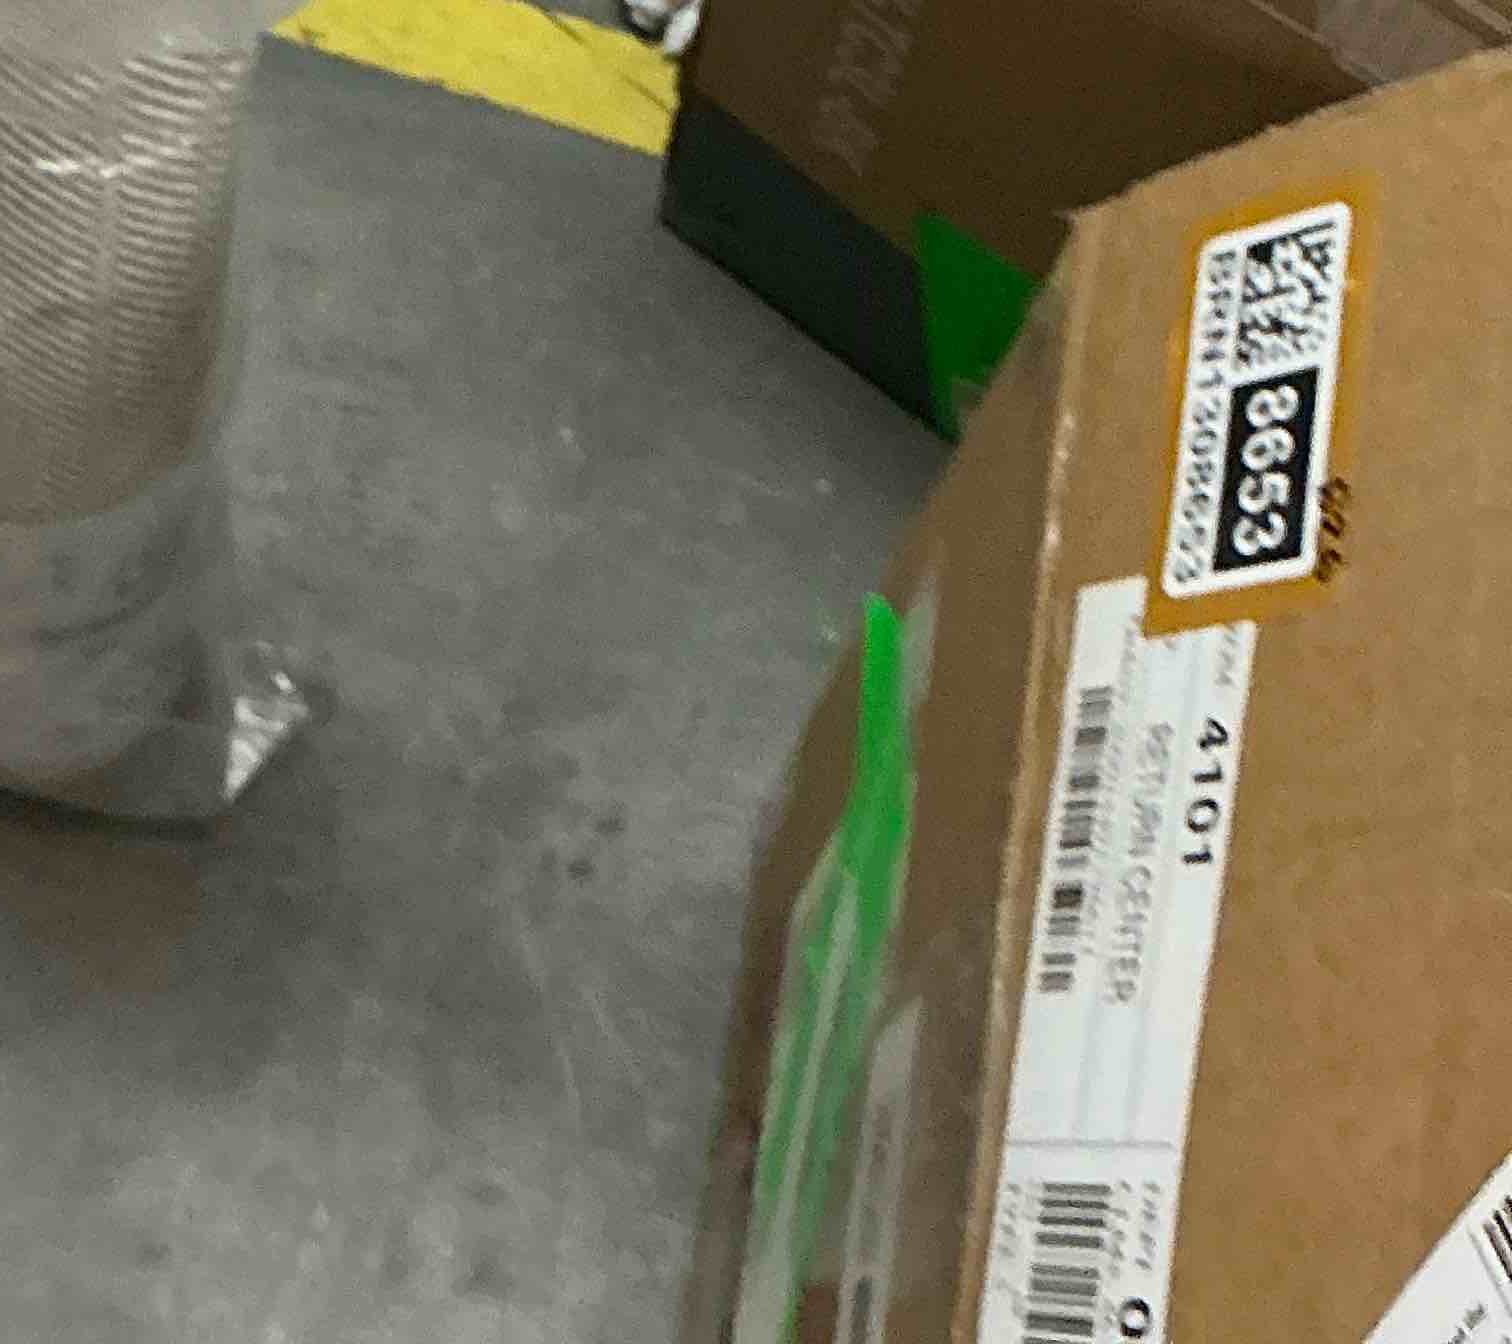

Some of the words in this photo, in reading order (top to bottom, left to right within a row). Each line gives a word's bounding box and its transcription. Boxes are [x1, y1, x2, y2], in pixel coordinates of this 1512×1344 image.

[1233, 384, 1300, 555] 8653
[1127, 723, 1174, 858] RETURN
[1182, 718, 1229, 865] 4101
[1107, 865, 1153, 1003] CENTER
